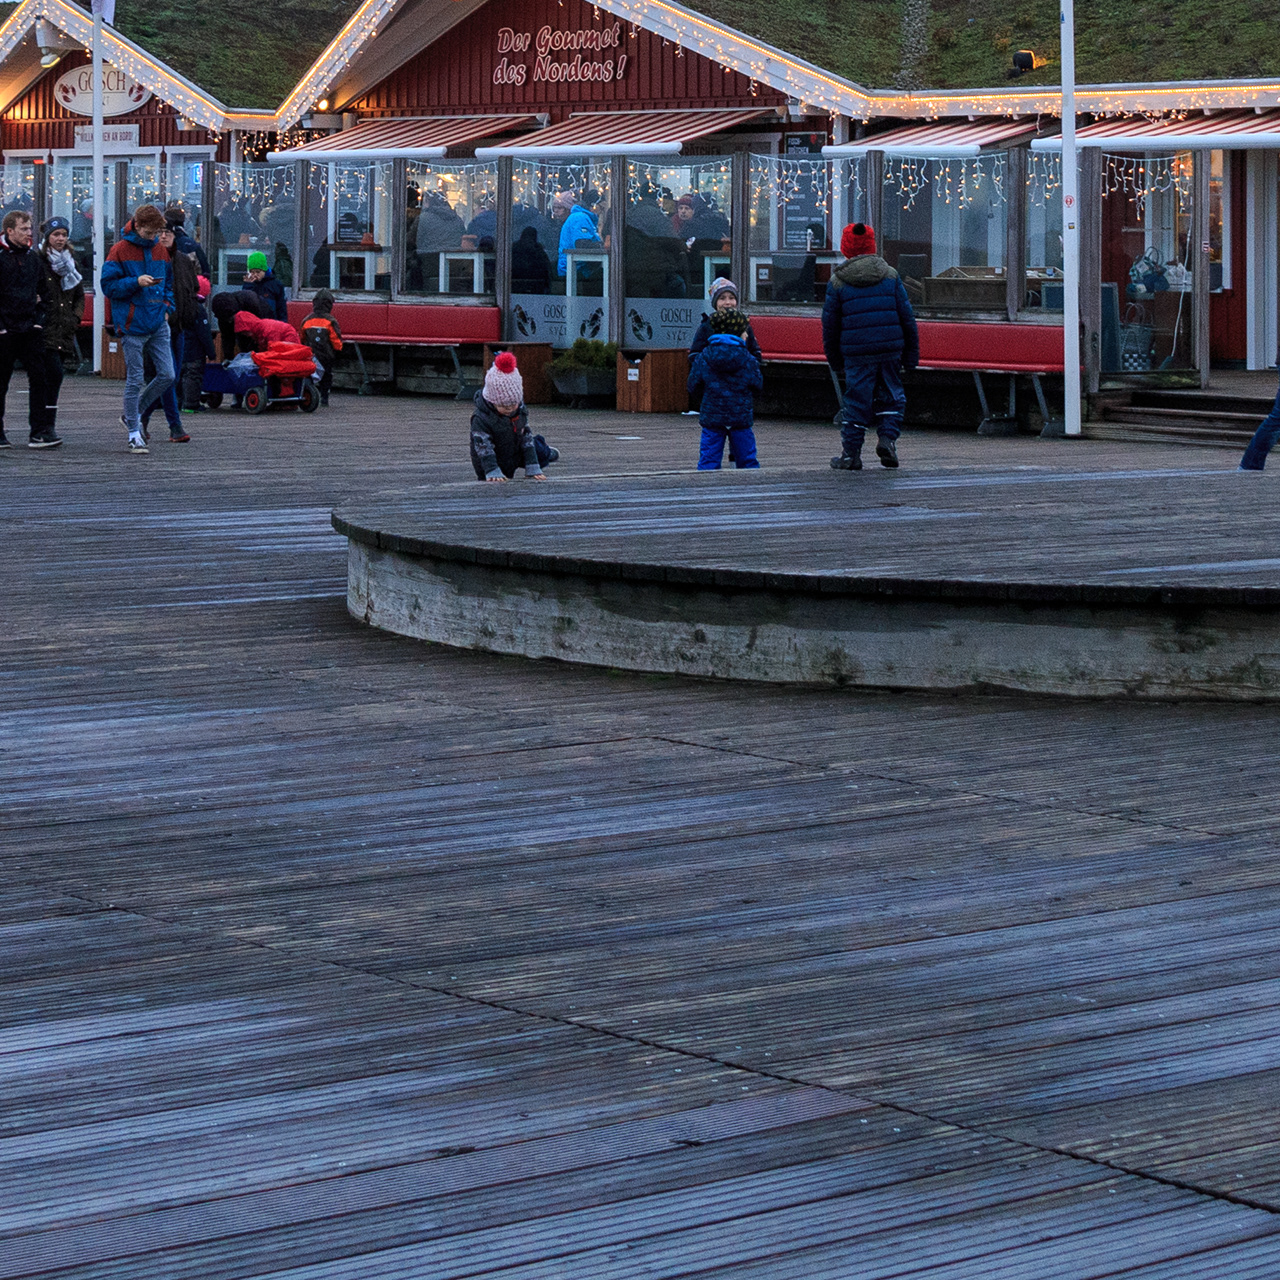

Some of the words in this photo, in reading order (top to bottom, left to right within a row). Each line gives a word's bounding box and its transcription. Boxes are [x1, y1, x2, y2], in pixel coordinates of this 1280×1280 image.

[498, 27, 531, 53] Der
[536, 22, 620, 57] Gourmet
[493, 57, 526, 86] des
[533, 54, 614, 82] Nordens
[660, 308, 692, 323] GOSCH
